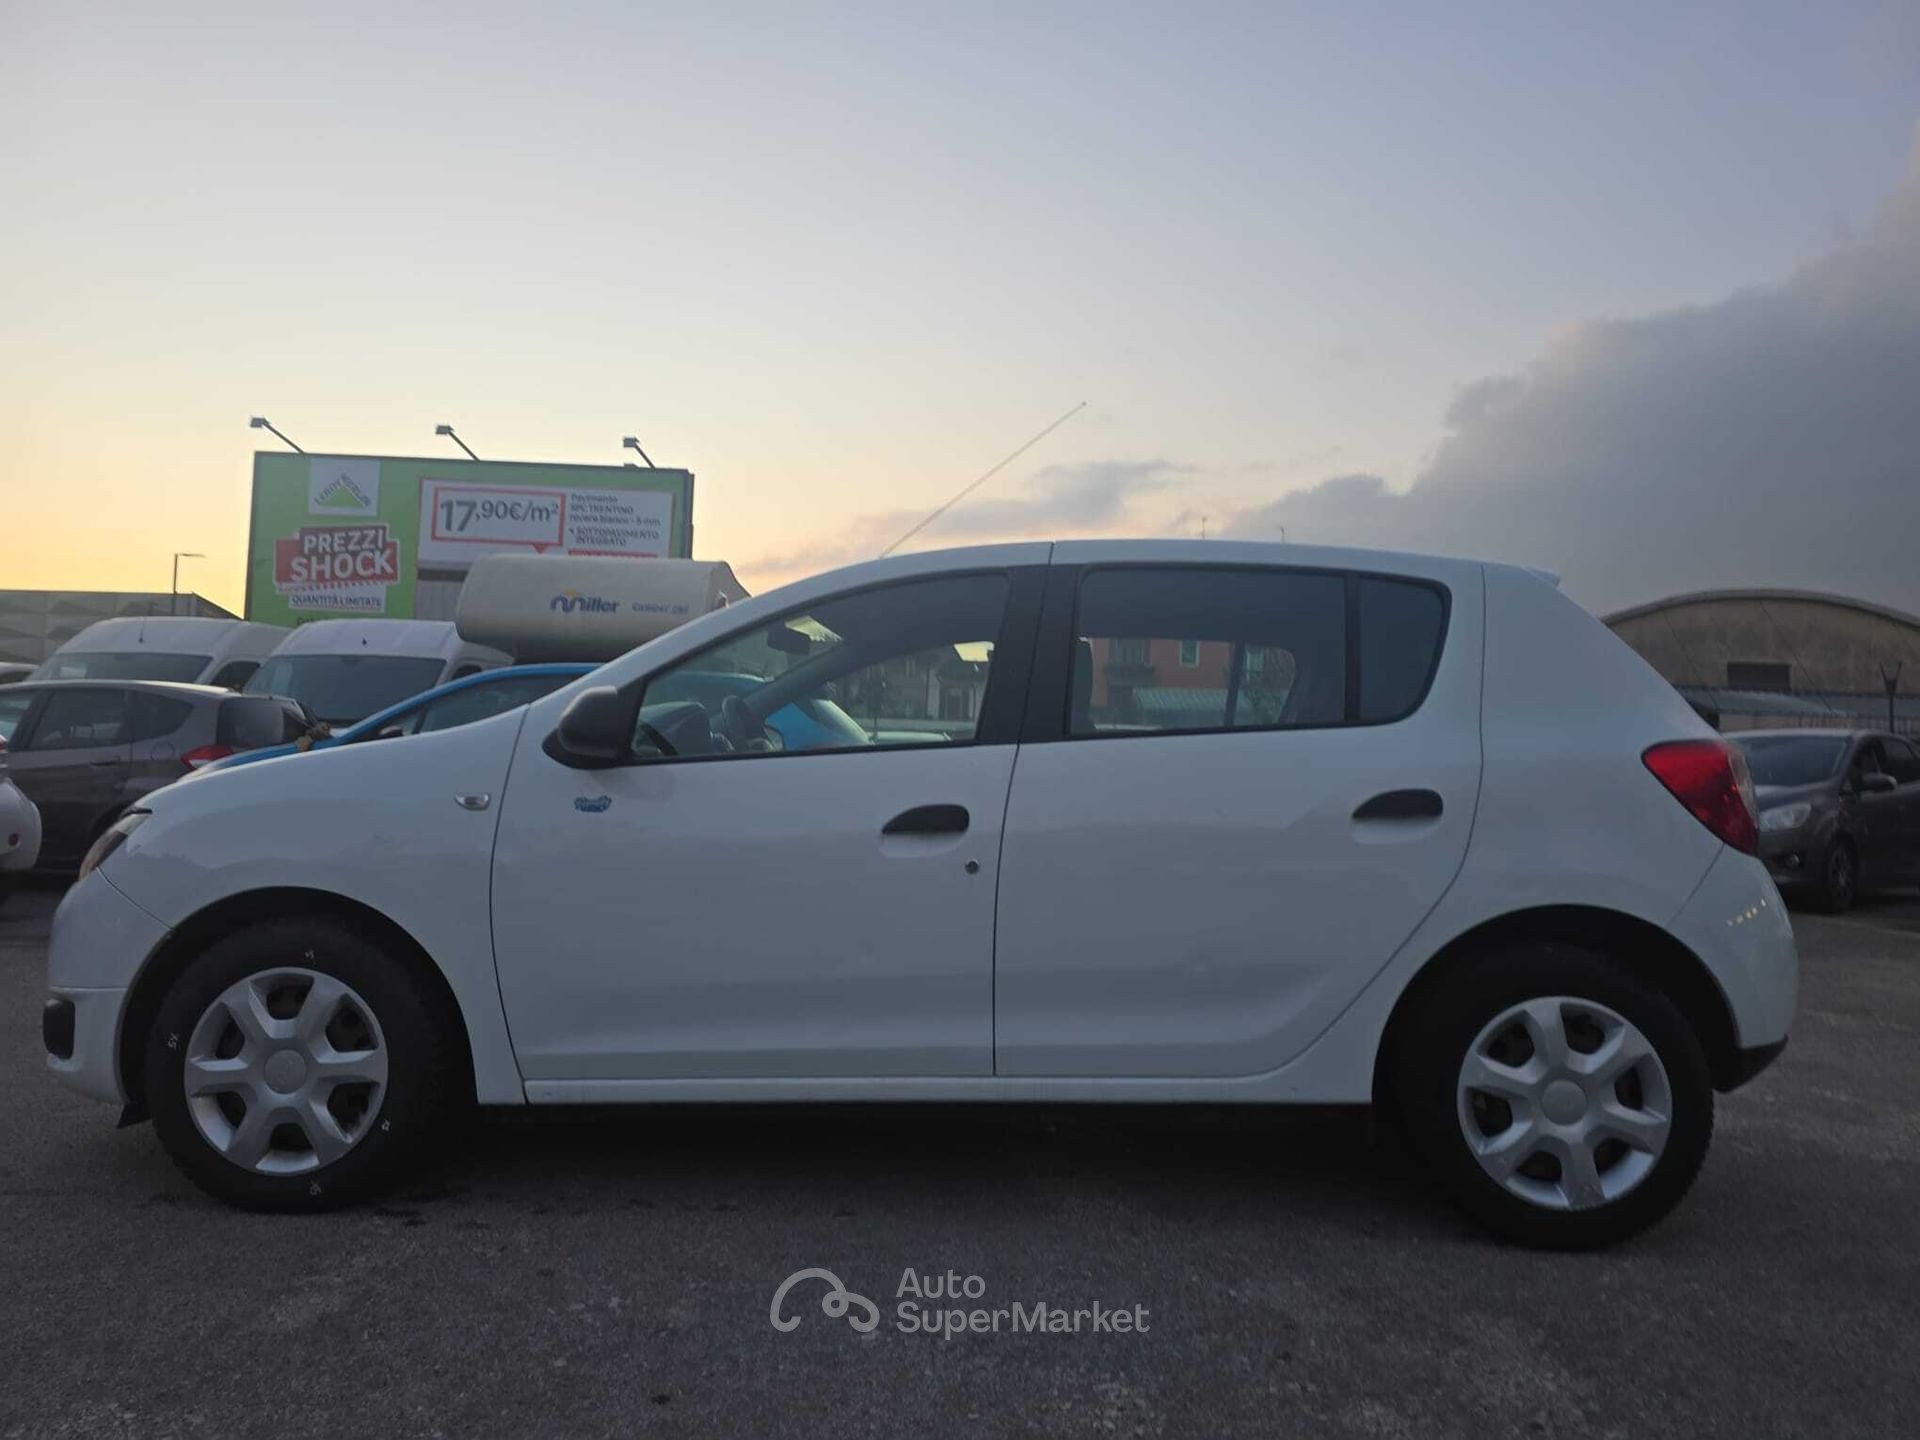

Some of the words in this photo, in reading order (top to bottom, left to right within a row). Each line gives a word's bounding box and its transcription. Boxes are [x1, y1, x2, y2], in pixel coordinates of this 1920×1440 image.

[589, 504, 634, 515] TRENTINO
[303, 528, 384, 555] PREZZI
[290, 549, 394, 582] SHOCK
